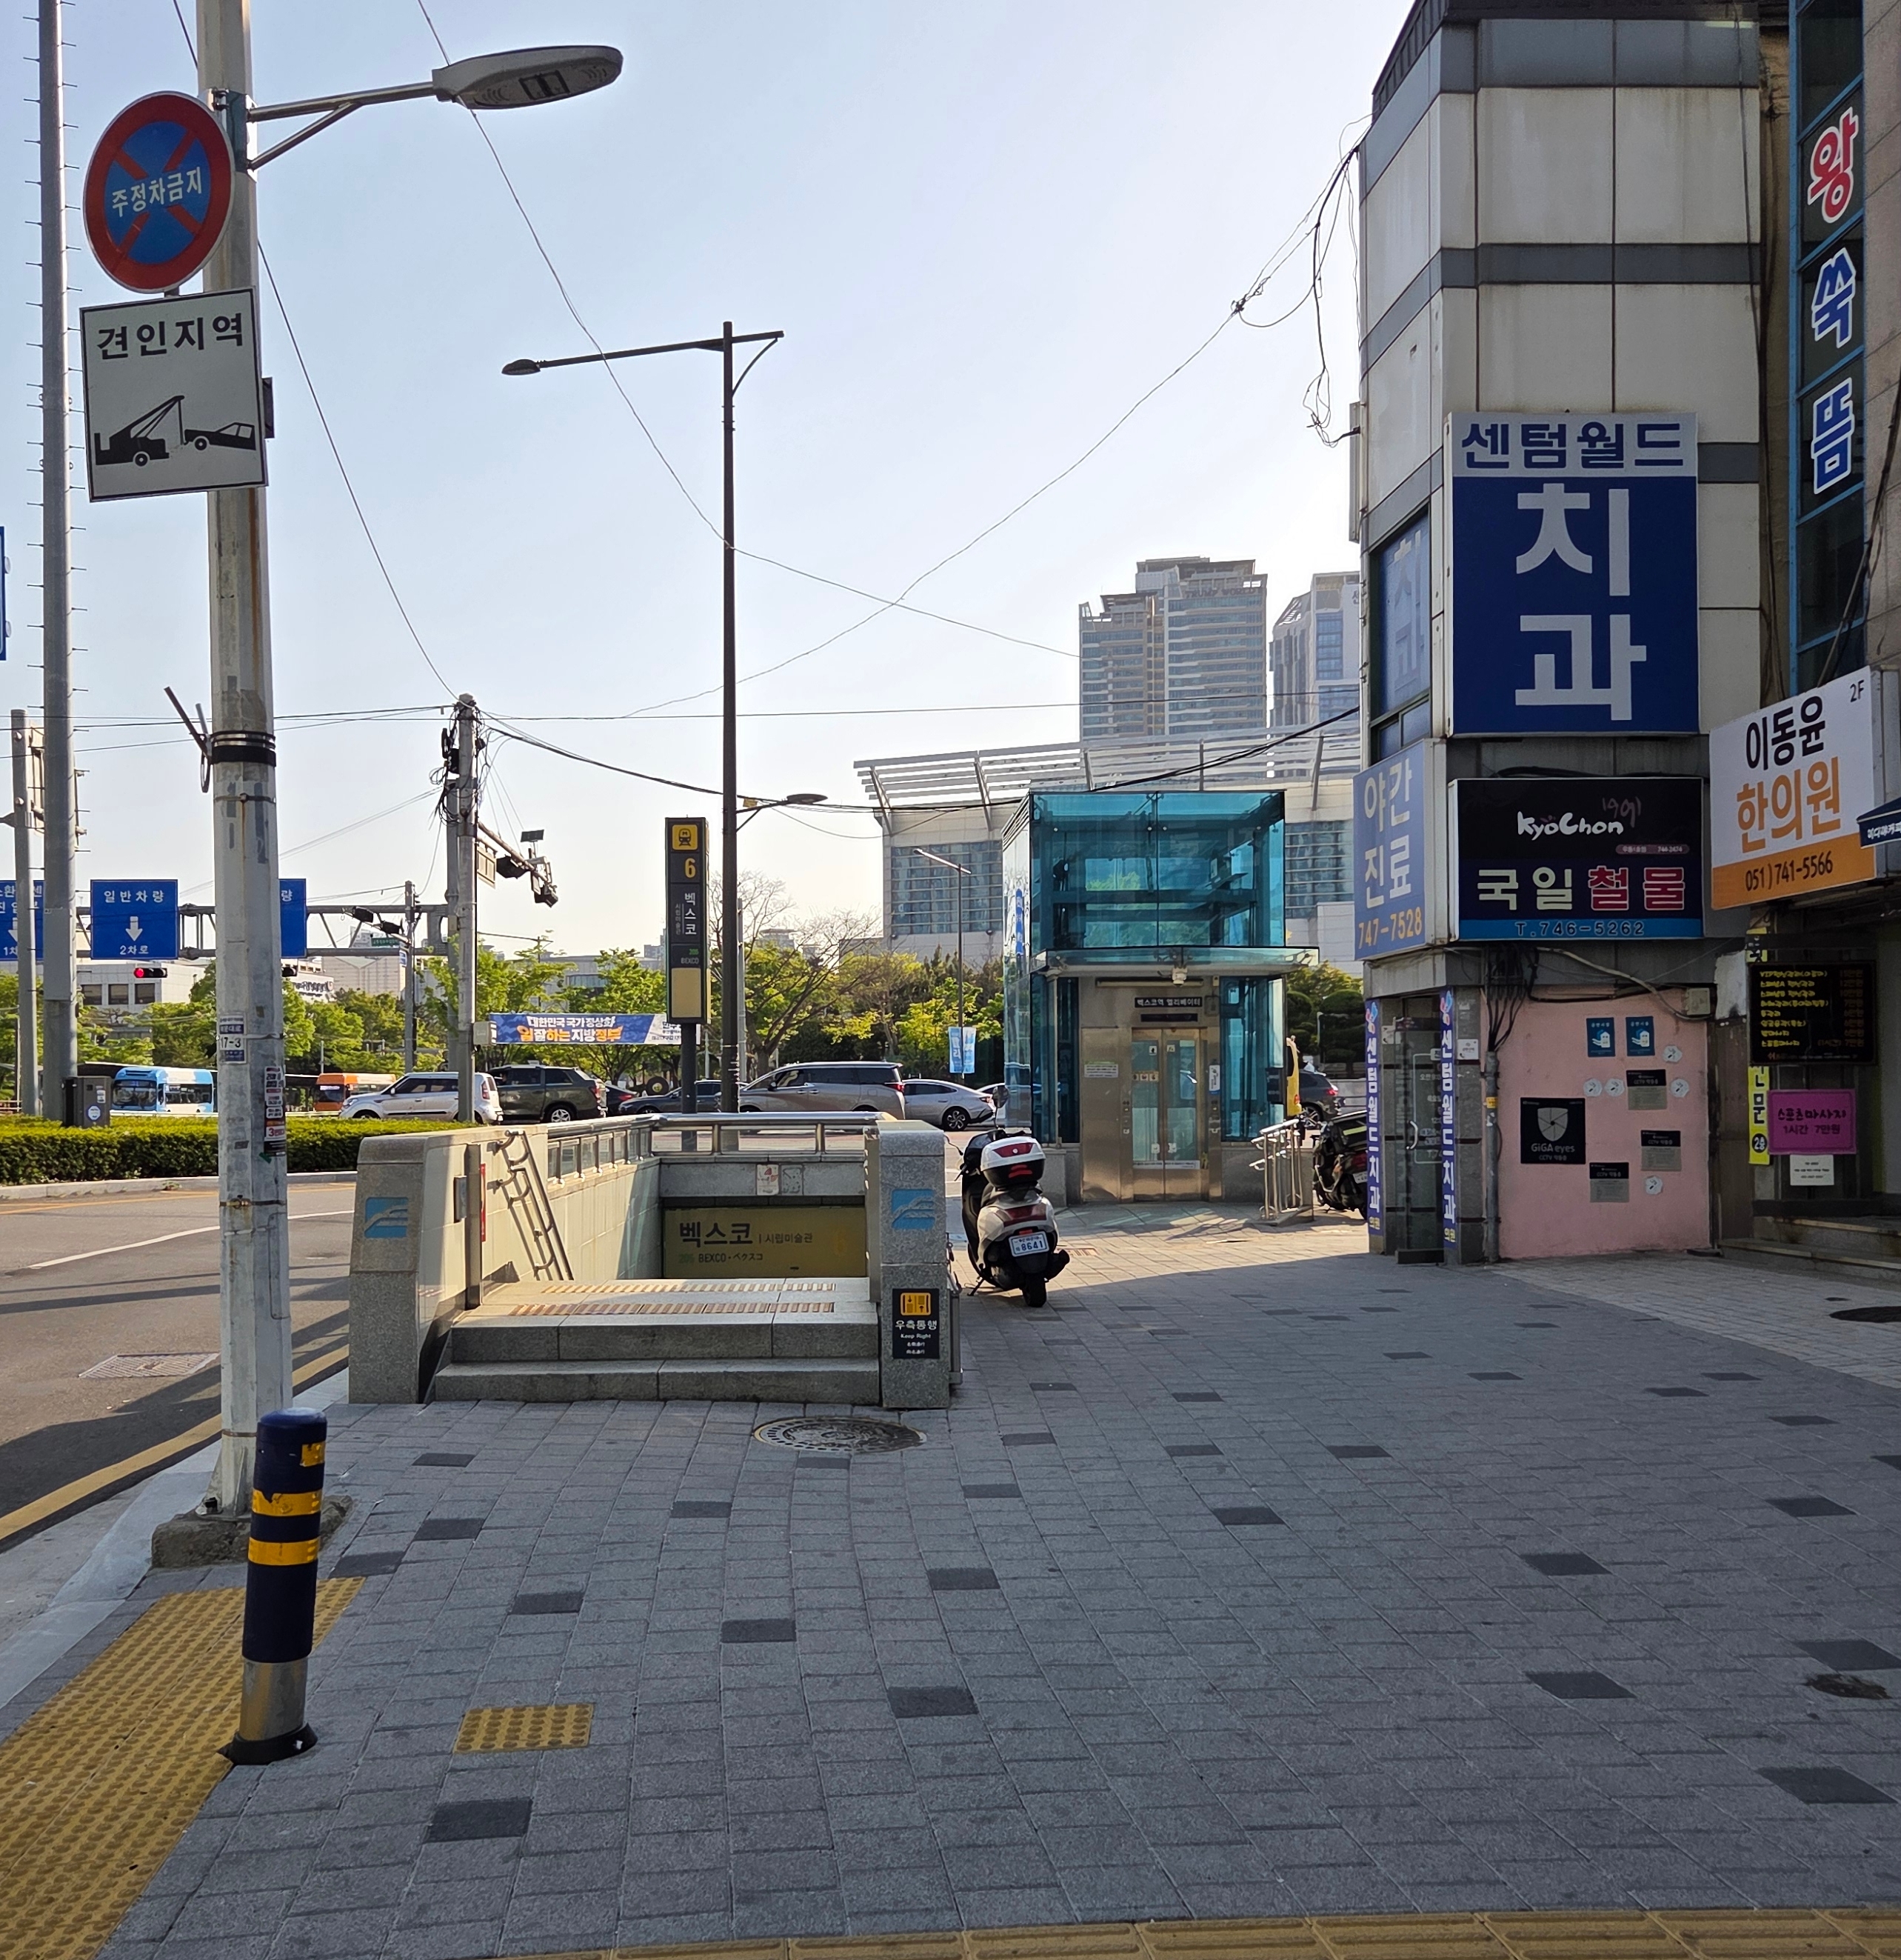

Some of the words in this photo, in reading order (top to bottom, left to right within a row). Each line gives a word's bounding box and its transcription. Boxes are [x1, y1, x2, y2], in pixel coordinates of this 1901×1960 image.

[112, 167, 202, 217] 주정차금지
[97, 313, 243, 360] 견인지역
[1461, 421, 1683, 470] 센텀월드
[1515, 484, 1647, 721] 치과
[1849, 679, 1865, 703] 2F
[1745, 694, 1825, 771] 이동윤
[1364, 759, 1412, 833] 야간
[1737, 757, 1841, 853] 한의원
[684, 858, 696, 878] 6
[1364, 837, 1411, 910] 진료
[1745, 850, 1834, 891] 051)741-5566
[104, 890, 164, 903] 일반차량
[1477, 865, 1685, 911] 국일철물
[684, 893, 697, 935] 벡스코
[1357, 907, 1423, 950] 747-7528
[1516, 921, 1645, 937] T.746-5262
[120, 944, 149, 956] 2차로
[526, 1016, 565, 1028] 대한민국
[571, 1026, 624, 1042] 지방정부
[1778, 1108, 1846, 1121] 스포츠마사지
[1783, 1124, 1808, 1135] 1시간
[1815, 1124, 1840, 1135] 7만원
[1531, 1143, 1554, 1153] GiGA
[1554, 1144, 1575, 1153] eyes
[1754, 1136, 1767, 1150] 2층
[679, 1221, 753, 1247] 벡스코
[765, 1233, 813, 1244] 시립미술관
[1021, 1241, 1043, 1250] 8641
[698, 1253, 726, 1262] BEXCO
[895, 1319, 938, 1330] 우측통행
